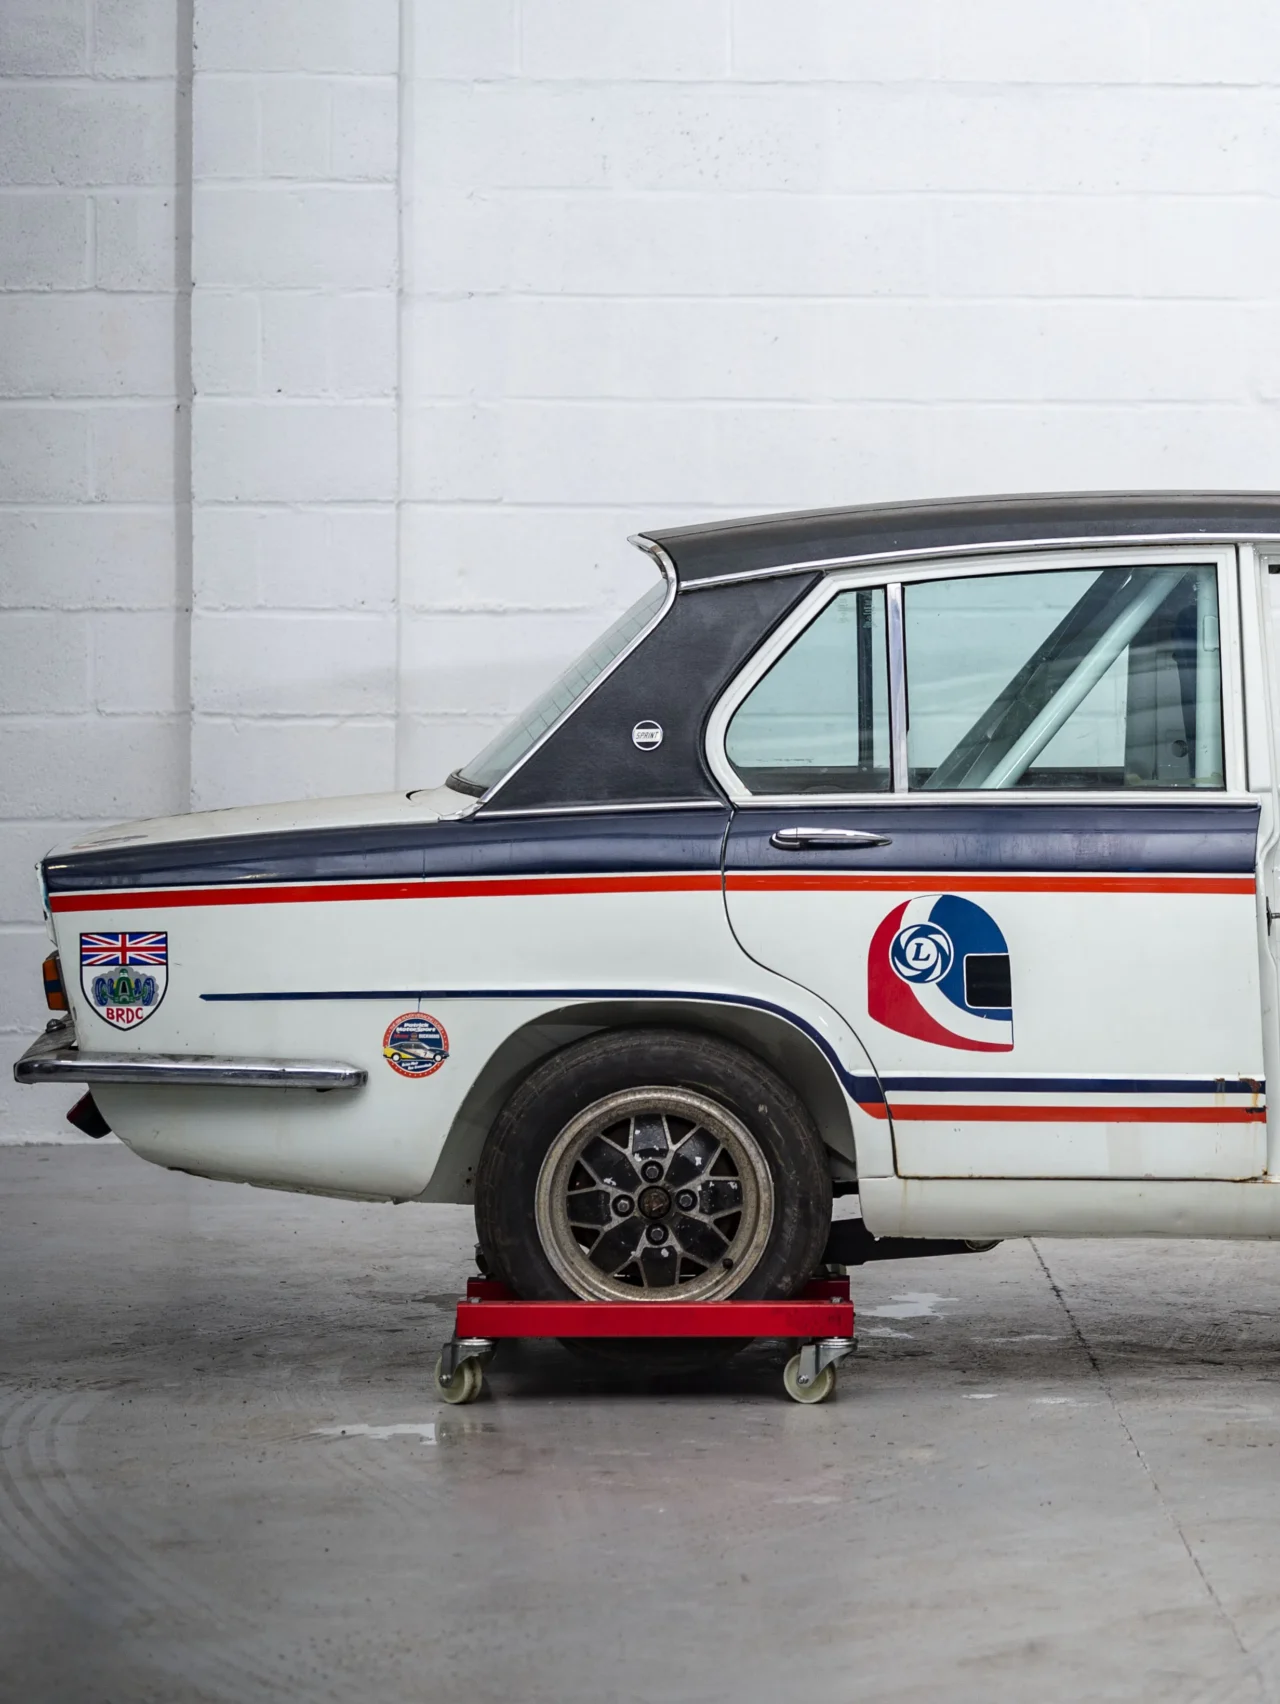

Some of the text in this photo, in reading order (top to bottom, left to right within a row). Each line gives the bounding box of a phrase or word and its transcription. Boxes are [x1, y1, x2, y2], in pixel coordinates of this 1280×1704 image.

[636, 731, 659, 739] SPRINT
[912, 943, 931, 961] L
[106, 1007, 144, 1024] BRDC
